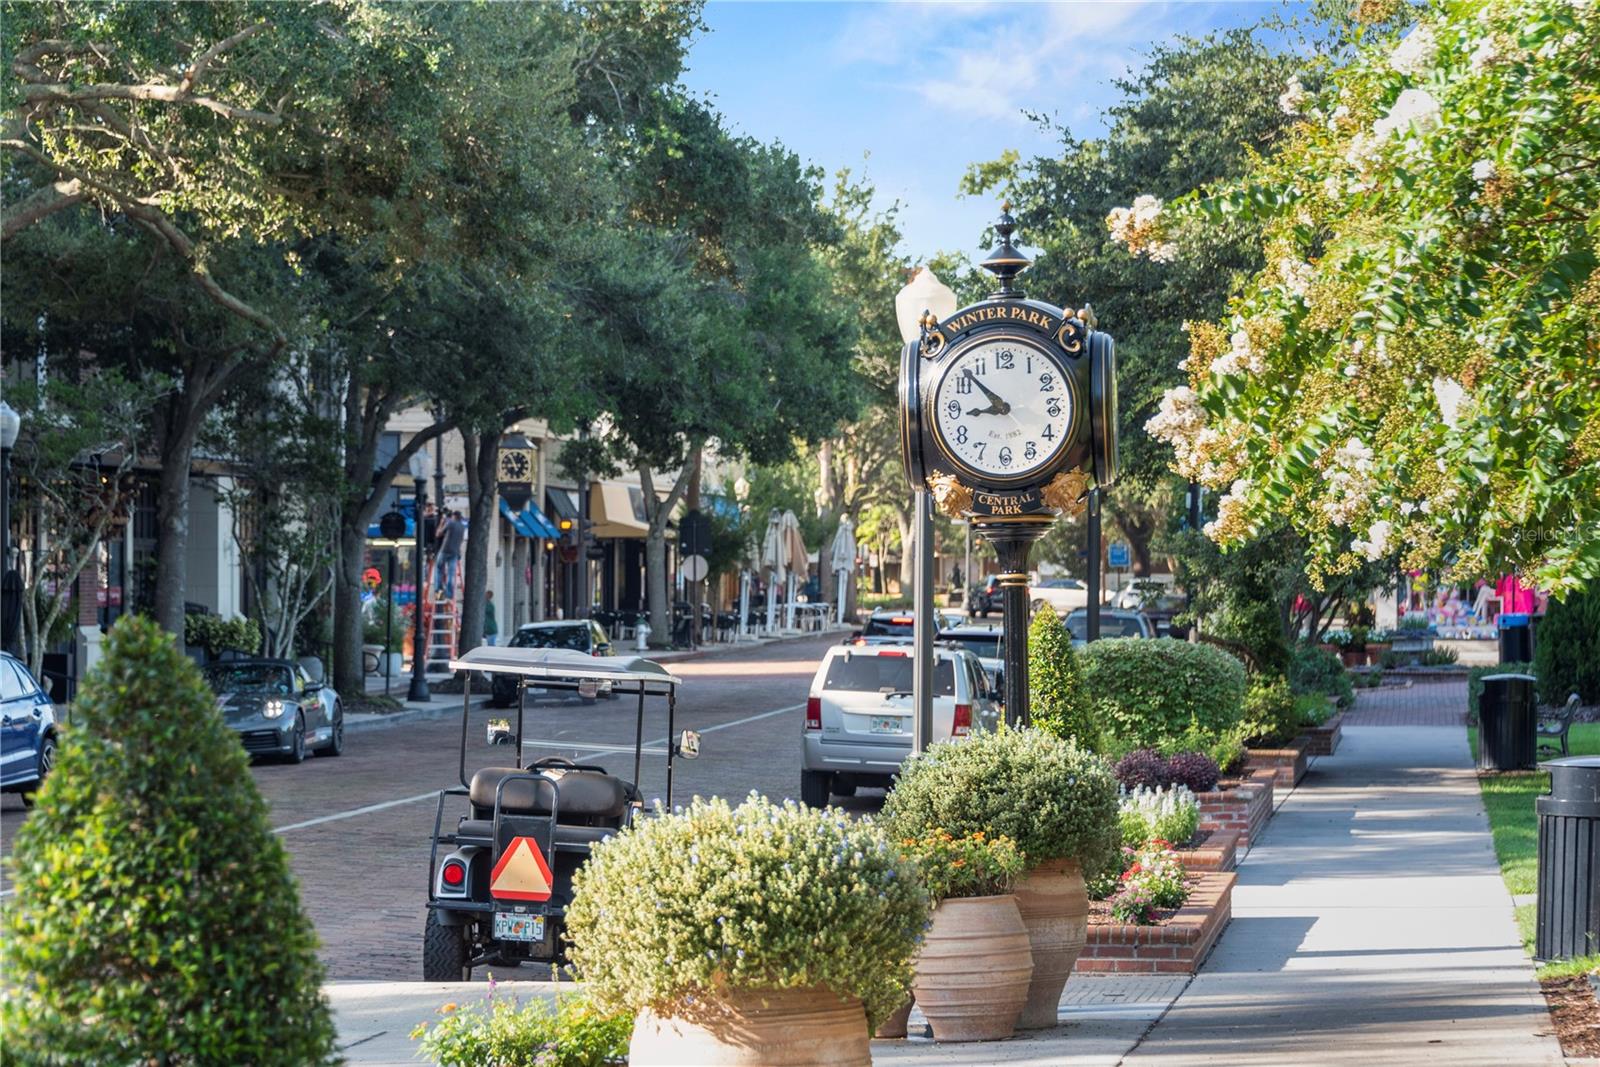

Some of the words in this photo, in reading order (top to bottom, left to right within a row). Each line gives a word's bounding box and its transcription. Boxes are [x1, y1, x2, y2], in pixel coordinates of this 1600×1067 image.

[947, 307, 1007, 332] WINTER
[1010, 307, 1053, 329] PARK
[975, 358, 986, 375] 11
[996, 351, 1015, 369] 12
[1027, 357, 1032, 374] 1
[956, 376, 972, 394] 10
[1039, 373, 1054, 392] 2
[948, 400, 961, 419] 9
[1046, 397, 1061, 417] 3
[956, 425, 968, 444] 8
[1041, 424, 1054, 441] 4
[973, 442, 986, 460] 7
[999, 447, 1012, 466] 6
[1025, 441, 1037, 460] 5
[978, 493, 1035, 506] CENTRAL
[991, 505, 1023, 514] PARK
